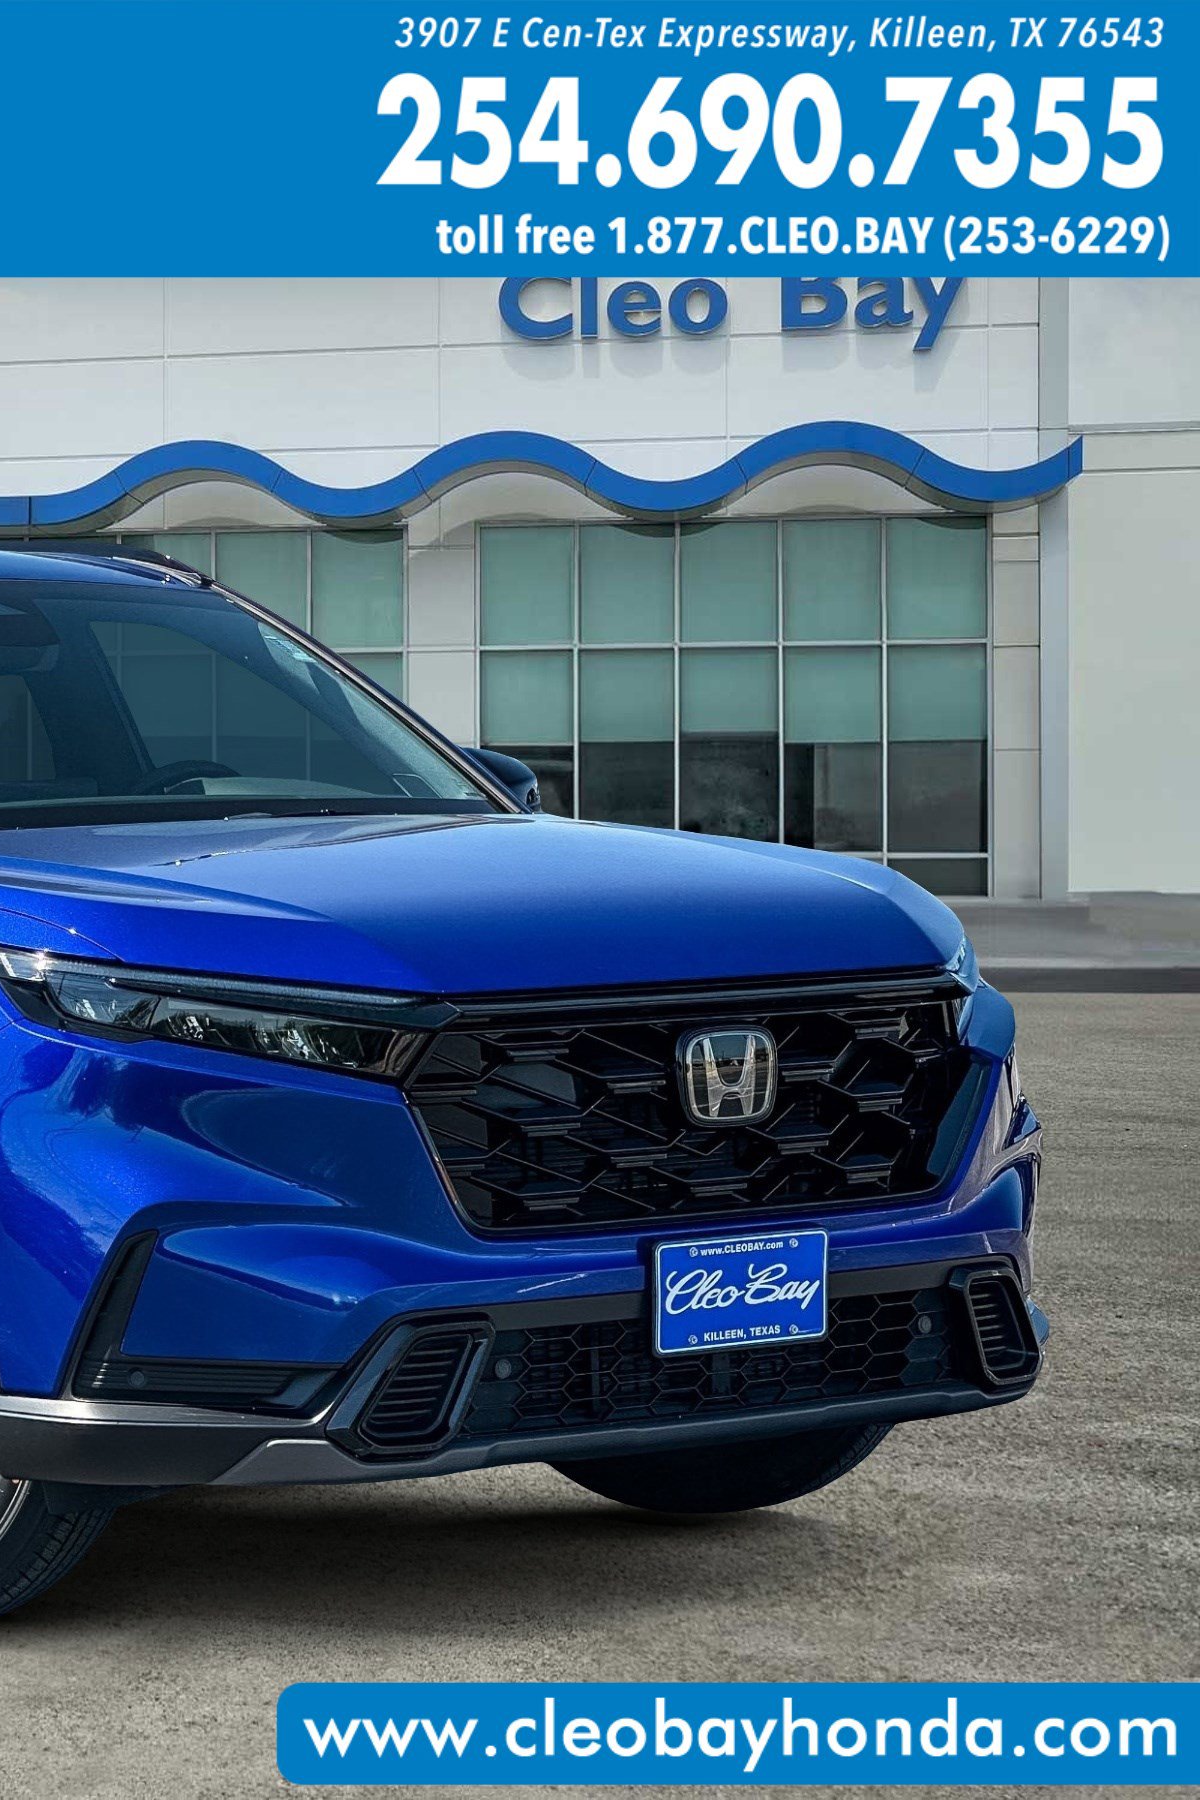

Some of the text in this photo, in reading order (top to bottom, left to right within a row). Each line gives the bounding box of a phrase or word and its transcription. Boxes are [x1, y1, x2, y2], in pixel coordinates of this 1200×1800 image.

[498, 277, 963, 351] Cleo Bay
[700, 1241, 783, 1256] www.CLEOBAY.com
[665, 1263, 820, 1315] Cleo Bay
[703, 1325, 781, 1342] KILLEEN, TEXAS
